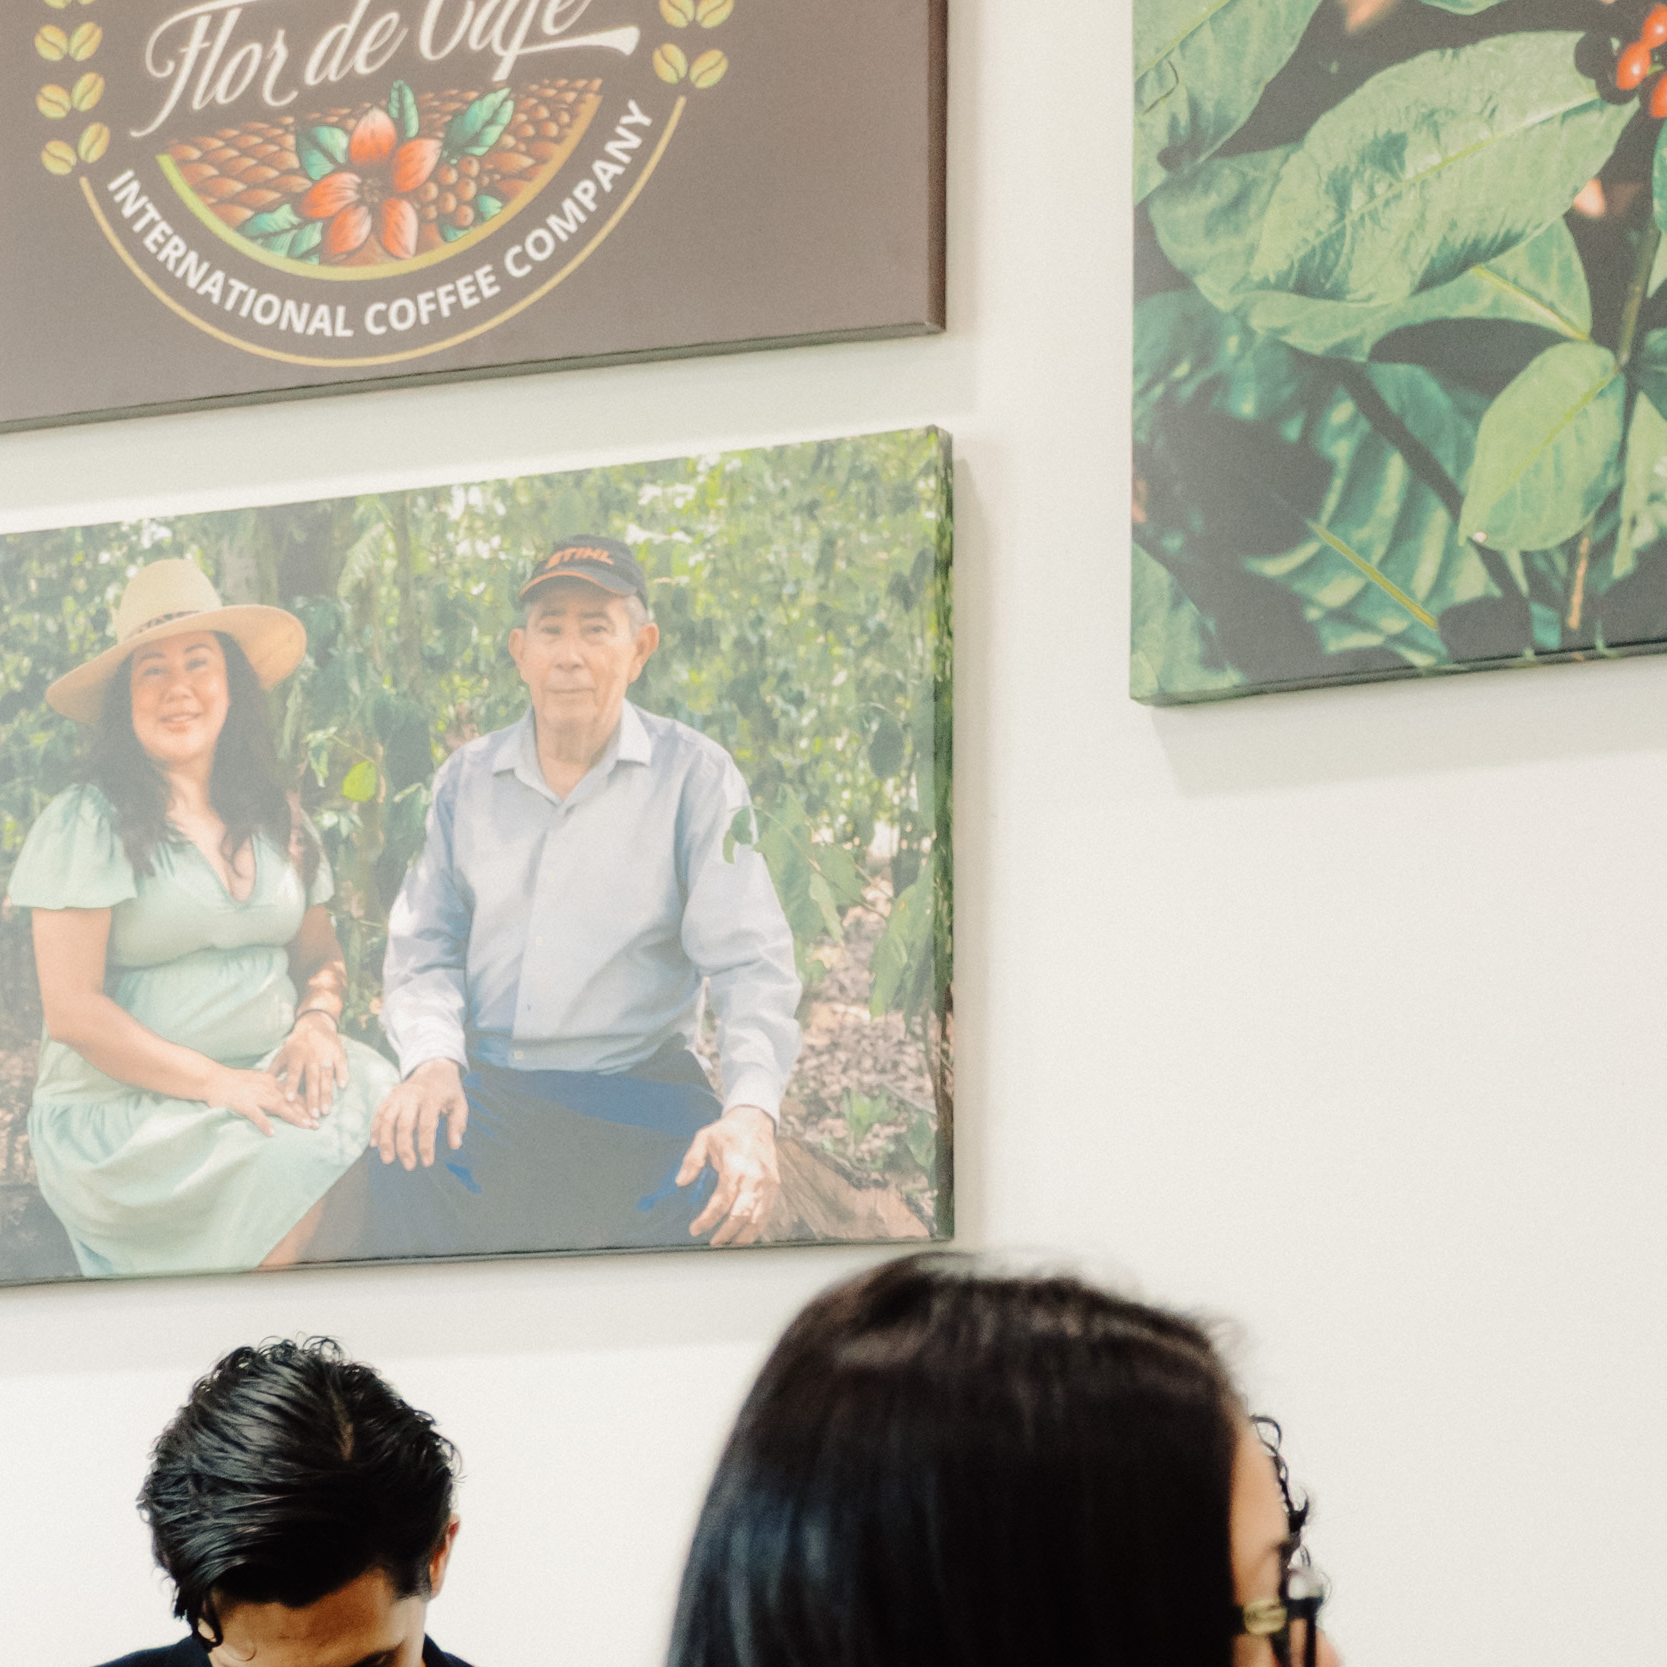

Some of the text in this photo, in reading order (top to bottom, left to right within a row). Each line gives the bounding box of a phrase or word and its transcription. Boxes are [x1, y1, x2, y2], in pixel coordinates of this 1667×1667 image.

[129, 0, 298, 138] Flor
[303, 0, 410, 88] de
[106, 99, 654, 337] INTERNATIONAL COFFEE COMPANY
